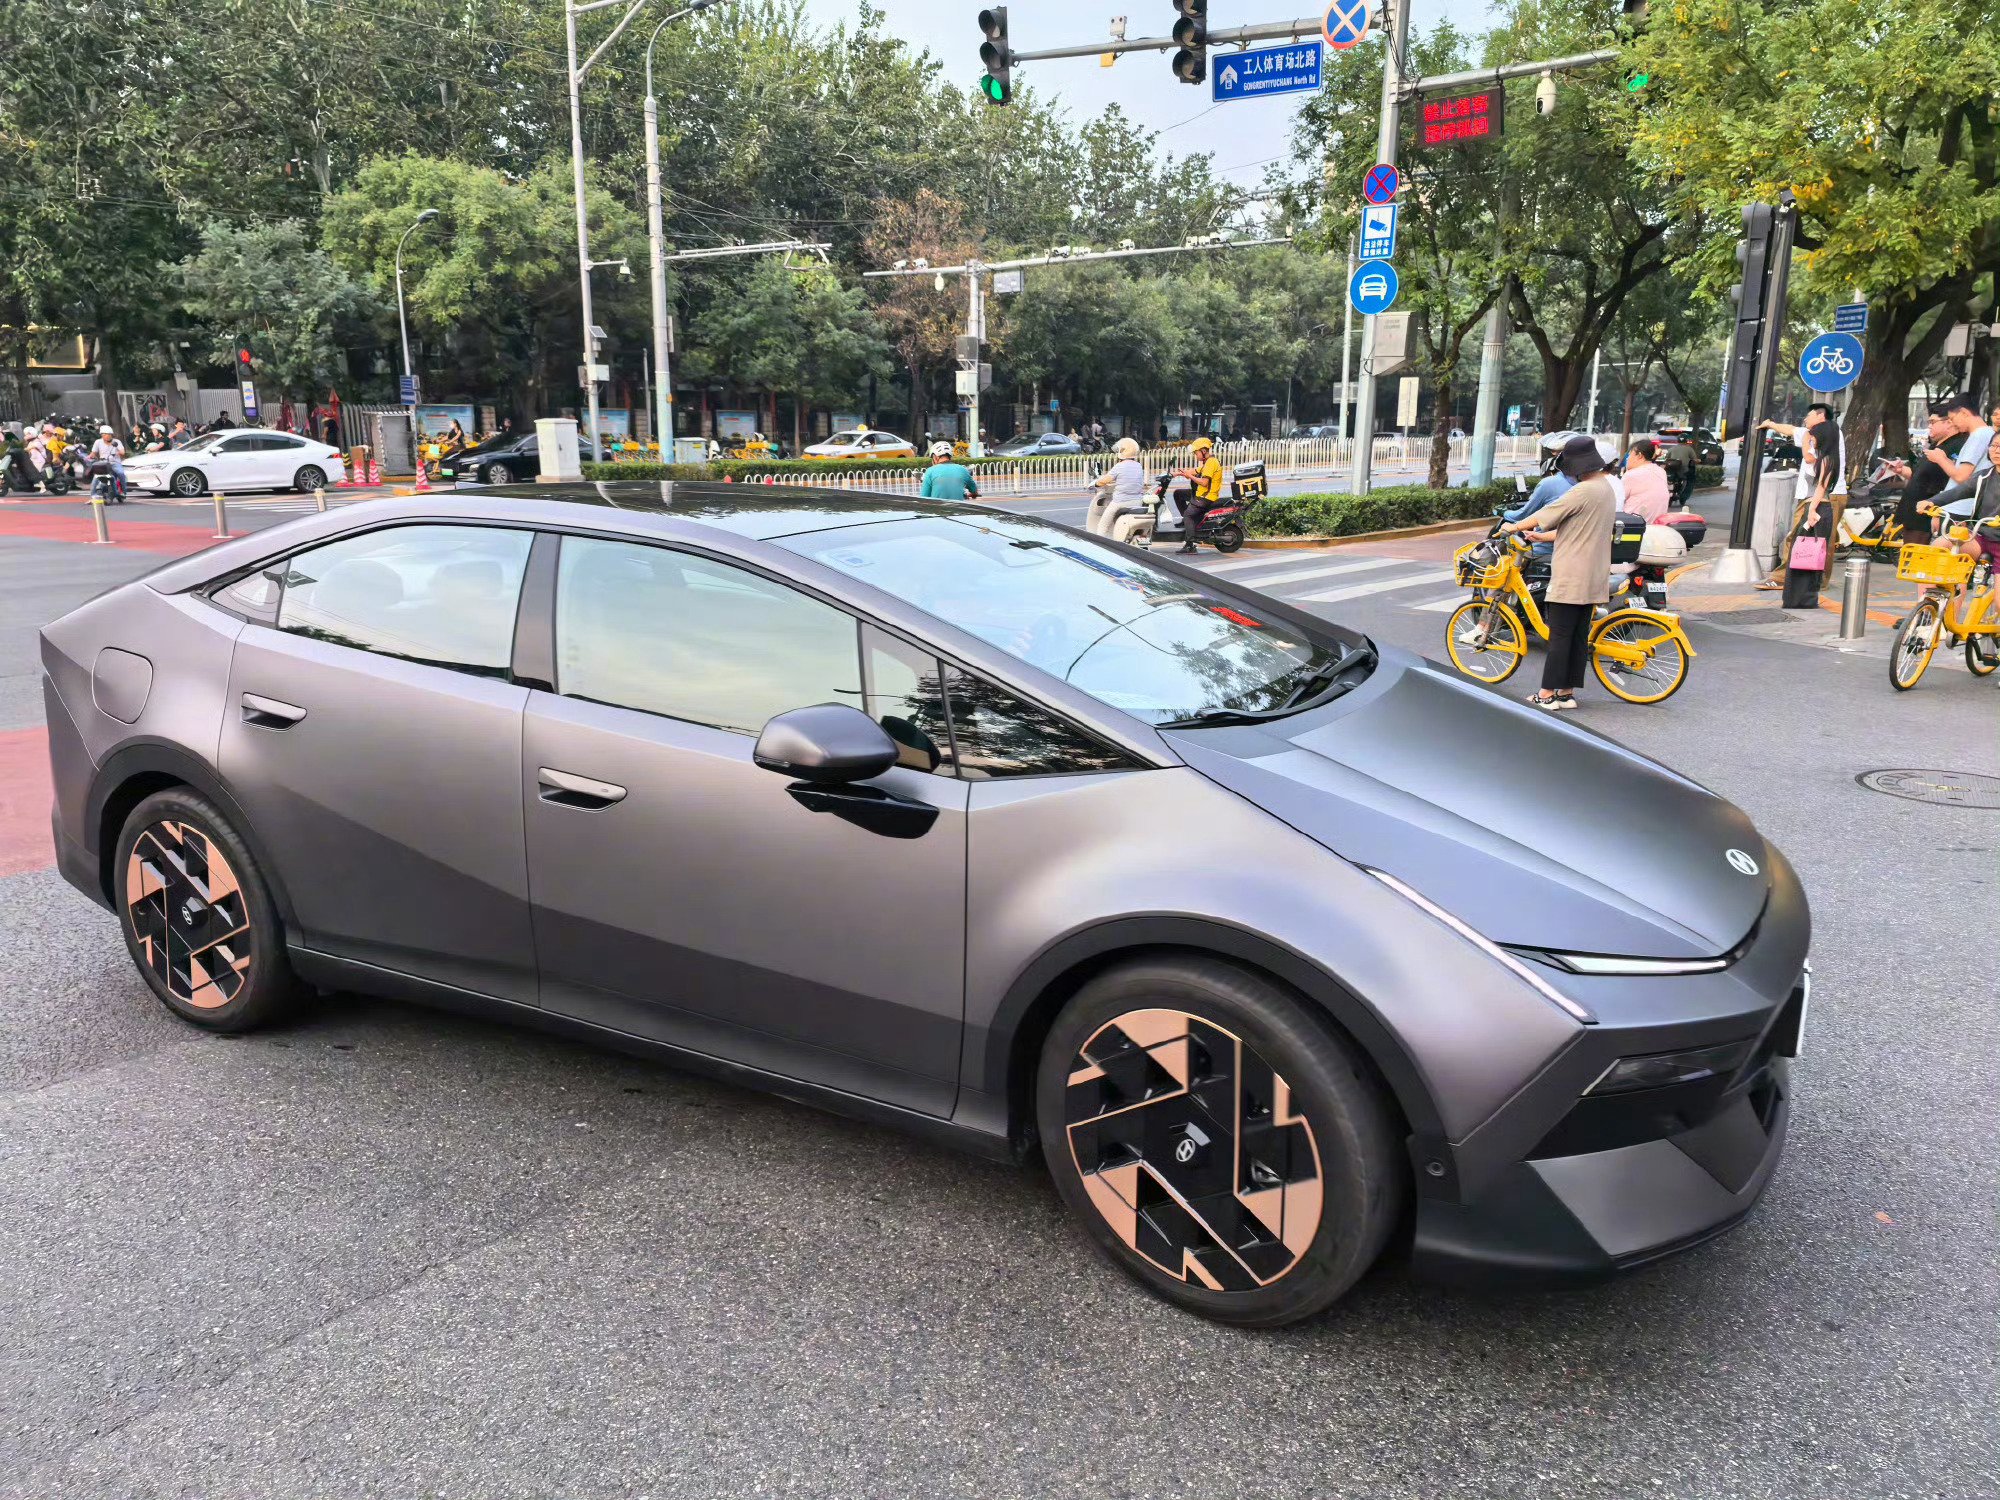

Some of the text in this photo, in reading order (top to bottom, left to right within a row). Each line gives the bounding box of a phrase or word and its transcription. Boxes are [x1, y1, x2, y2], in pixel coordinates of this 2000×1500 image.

[1243, 48, 1317, 75] 工人体育场北路
[1293, 75, 1308, 85] North
[1308, 74, 1316, 84] Rd
